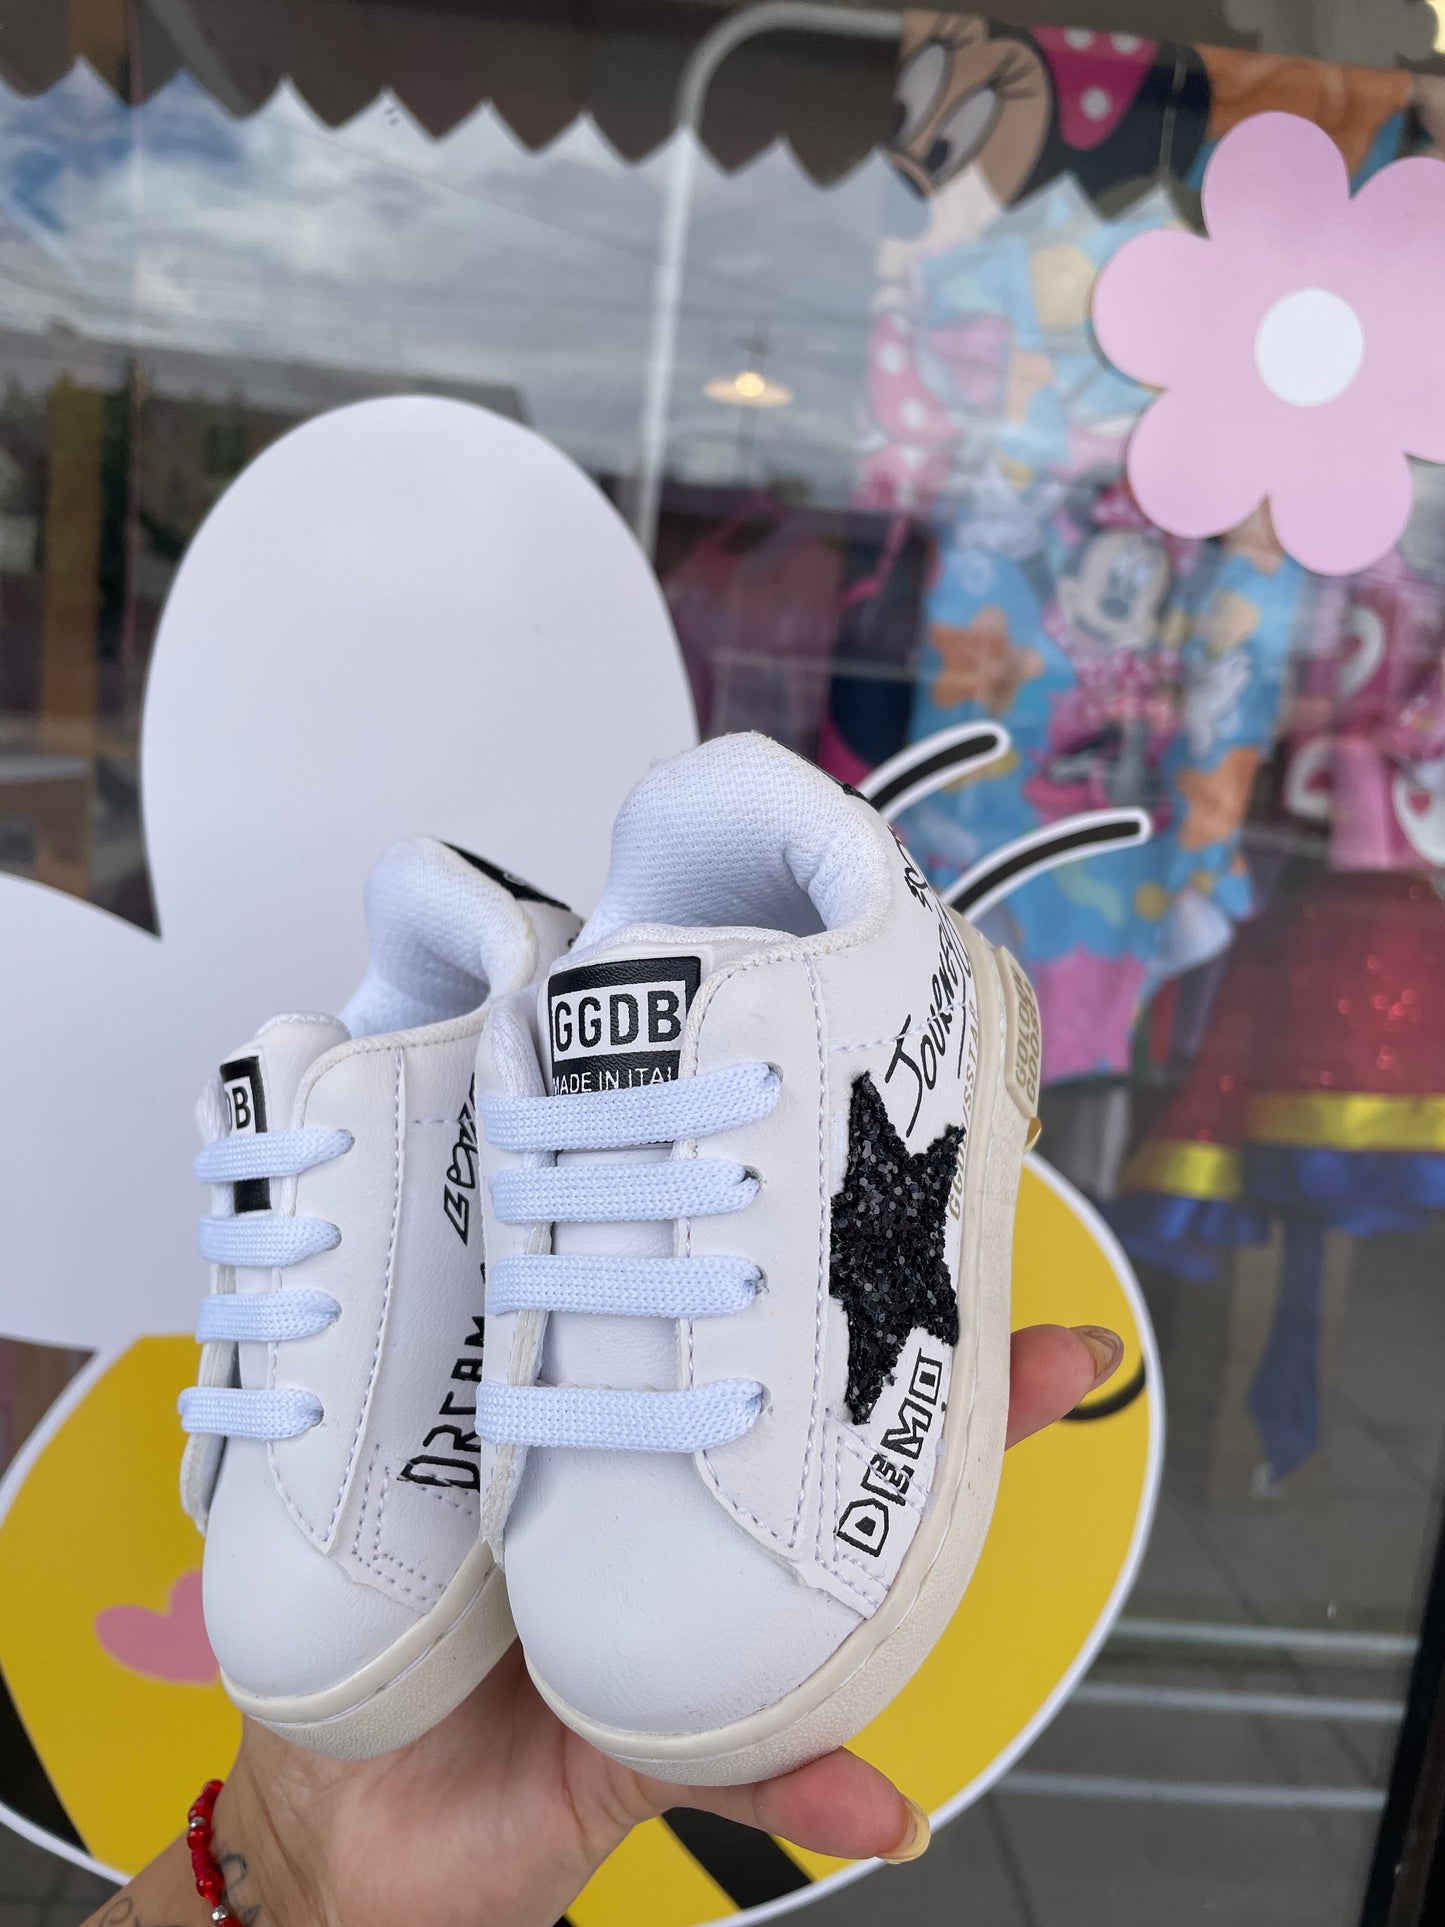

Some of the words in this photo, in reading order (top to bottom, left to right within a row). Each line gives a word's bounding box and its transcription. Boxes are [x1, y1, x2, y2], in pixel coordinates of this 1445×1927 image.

[555, 990, 682, 1051] GGDB
[552, 1072, 593, 1096] MADE
[598, 1069, 620, 1091] IN
[836, 1347, 942, 1557] DEMO
